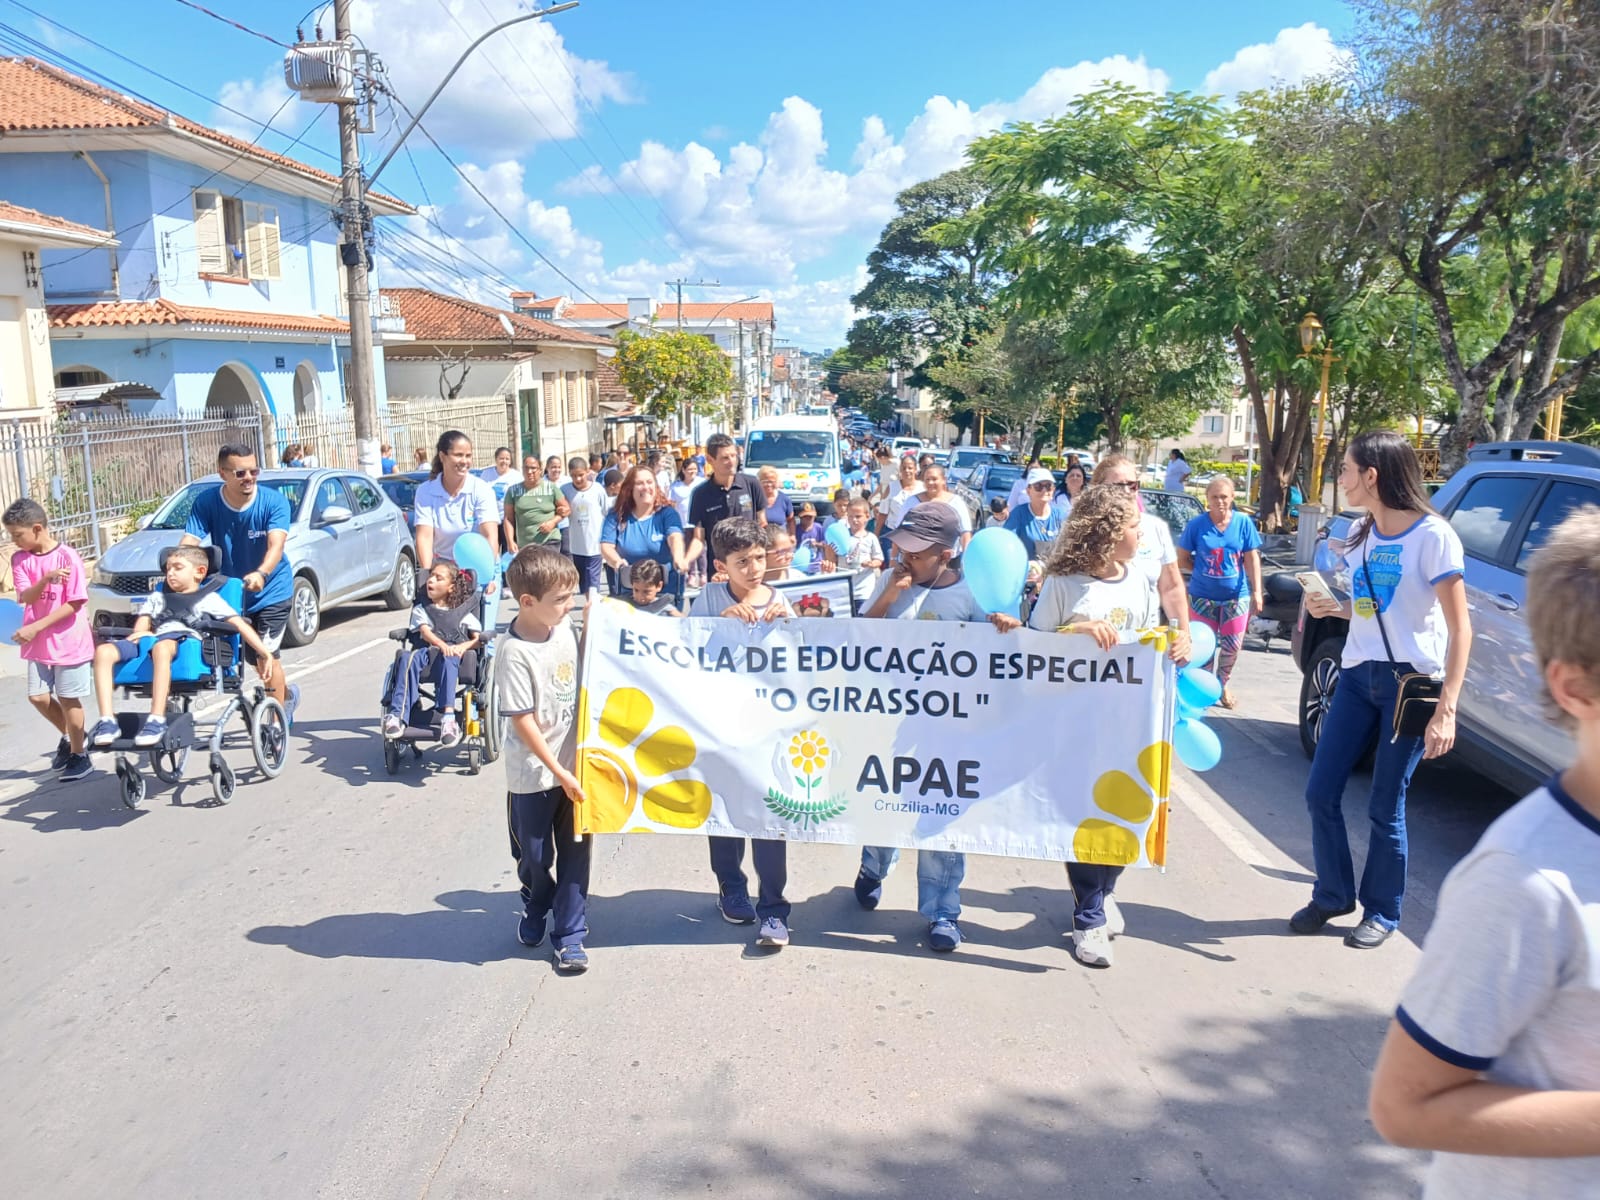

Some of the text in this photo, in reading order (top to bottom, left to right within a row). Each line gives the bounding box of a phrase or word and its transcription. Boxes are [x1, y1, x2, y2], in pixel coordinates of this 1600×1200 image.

[618, 628, 1143, 685] ESCOLA DE EDUCAÇÃO ESPECIAL
[856, 754, 981, 799] APAE
[874, 799, 960, 816] Cruzília-MG
